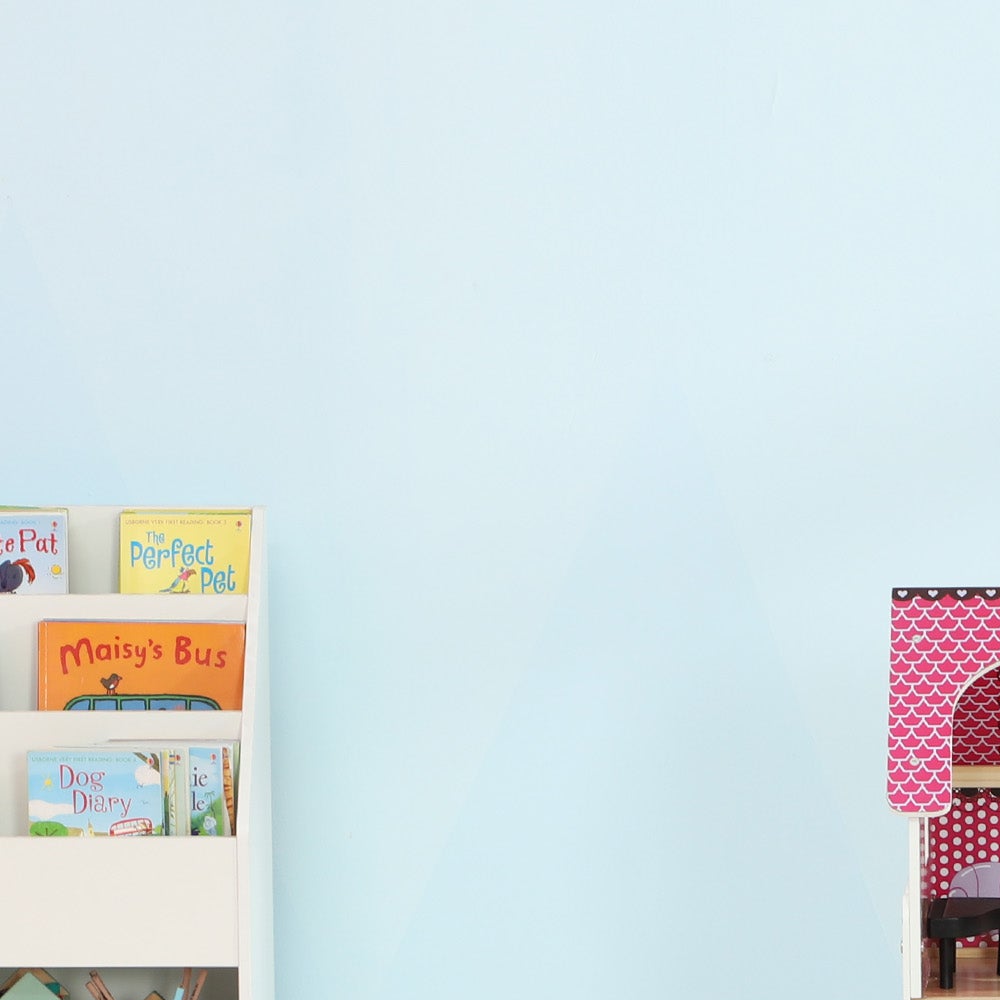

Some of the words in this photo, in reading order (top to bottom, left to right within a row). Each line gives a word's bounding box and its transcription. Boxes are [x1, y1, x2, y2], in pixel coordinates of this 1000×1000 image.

[18, 528, 57, 554] Pat
[146, 531, 165, 546] The
[131, 538, 215, 570] Perfect
[201, 564, 236, 594] Pet
[60, 635, 163, 675] Maisy's
[174, 635, 228, 668] Bus
[60, 764, 105, 792] Dog
[72, 789, 132, 817] Diary
